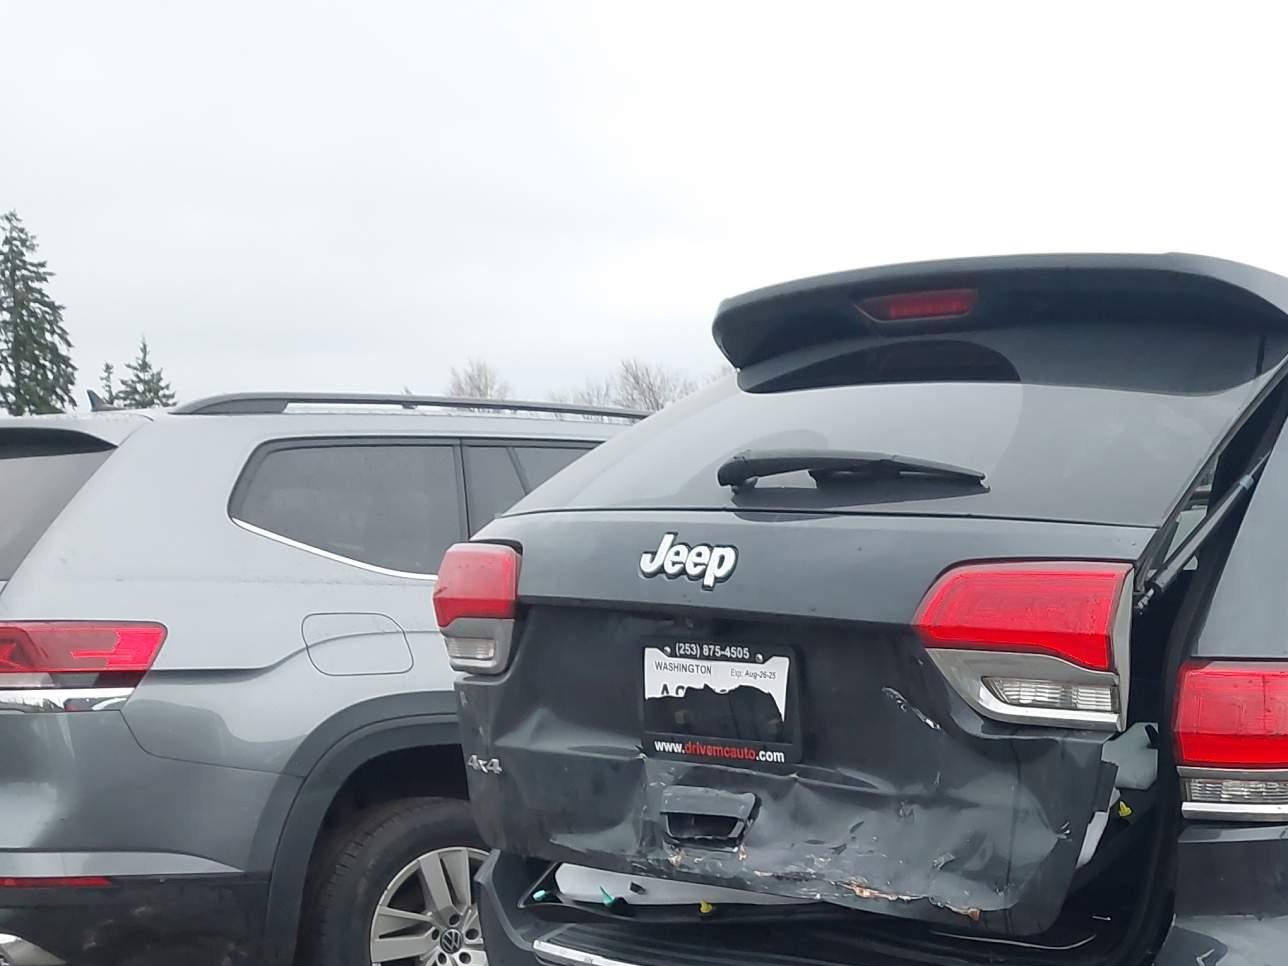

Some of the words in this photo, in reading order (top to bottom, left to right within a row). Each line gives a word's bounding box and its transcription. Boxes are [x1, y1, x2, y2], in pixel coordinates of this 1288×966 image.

[639, 532, 738, 590] Jeep
[675, 642, 700, 658] (253)
[702, 645, 750, 659] 875-4505
[654, 660, 712, 675] WASHINGTON
[654, 740, 785, 763] www.drivemcauto.com
[468, 754, 502, 774] 4x4
